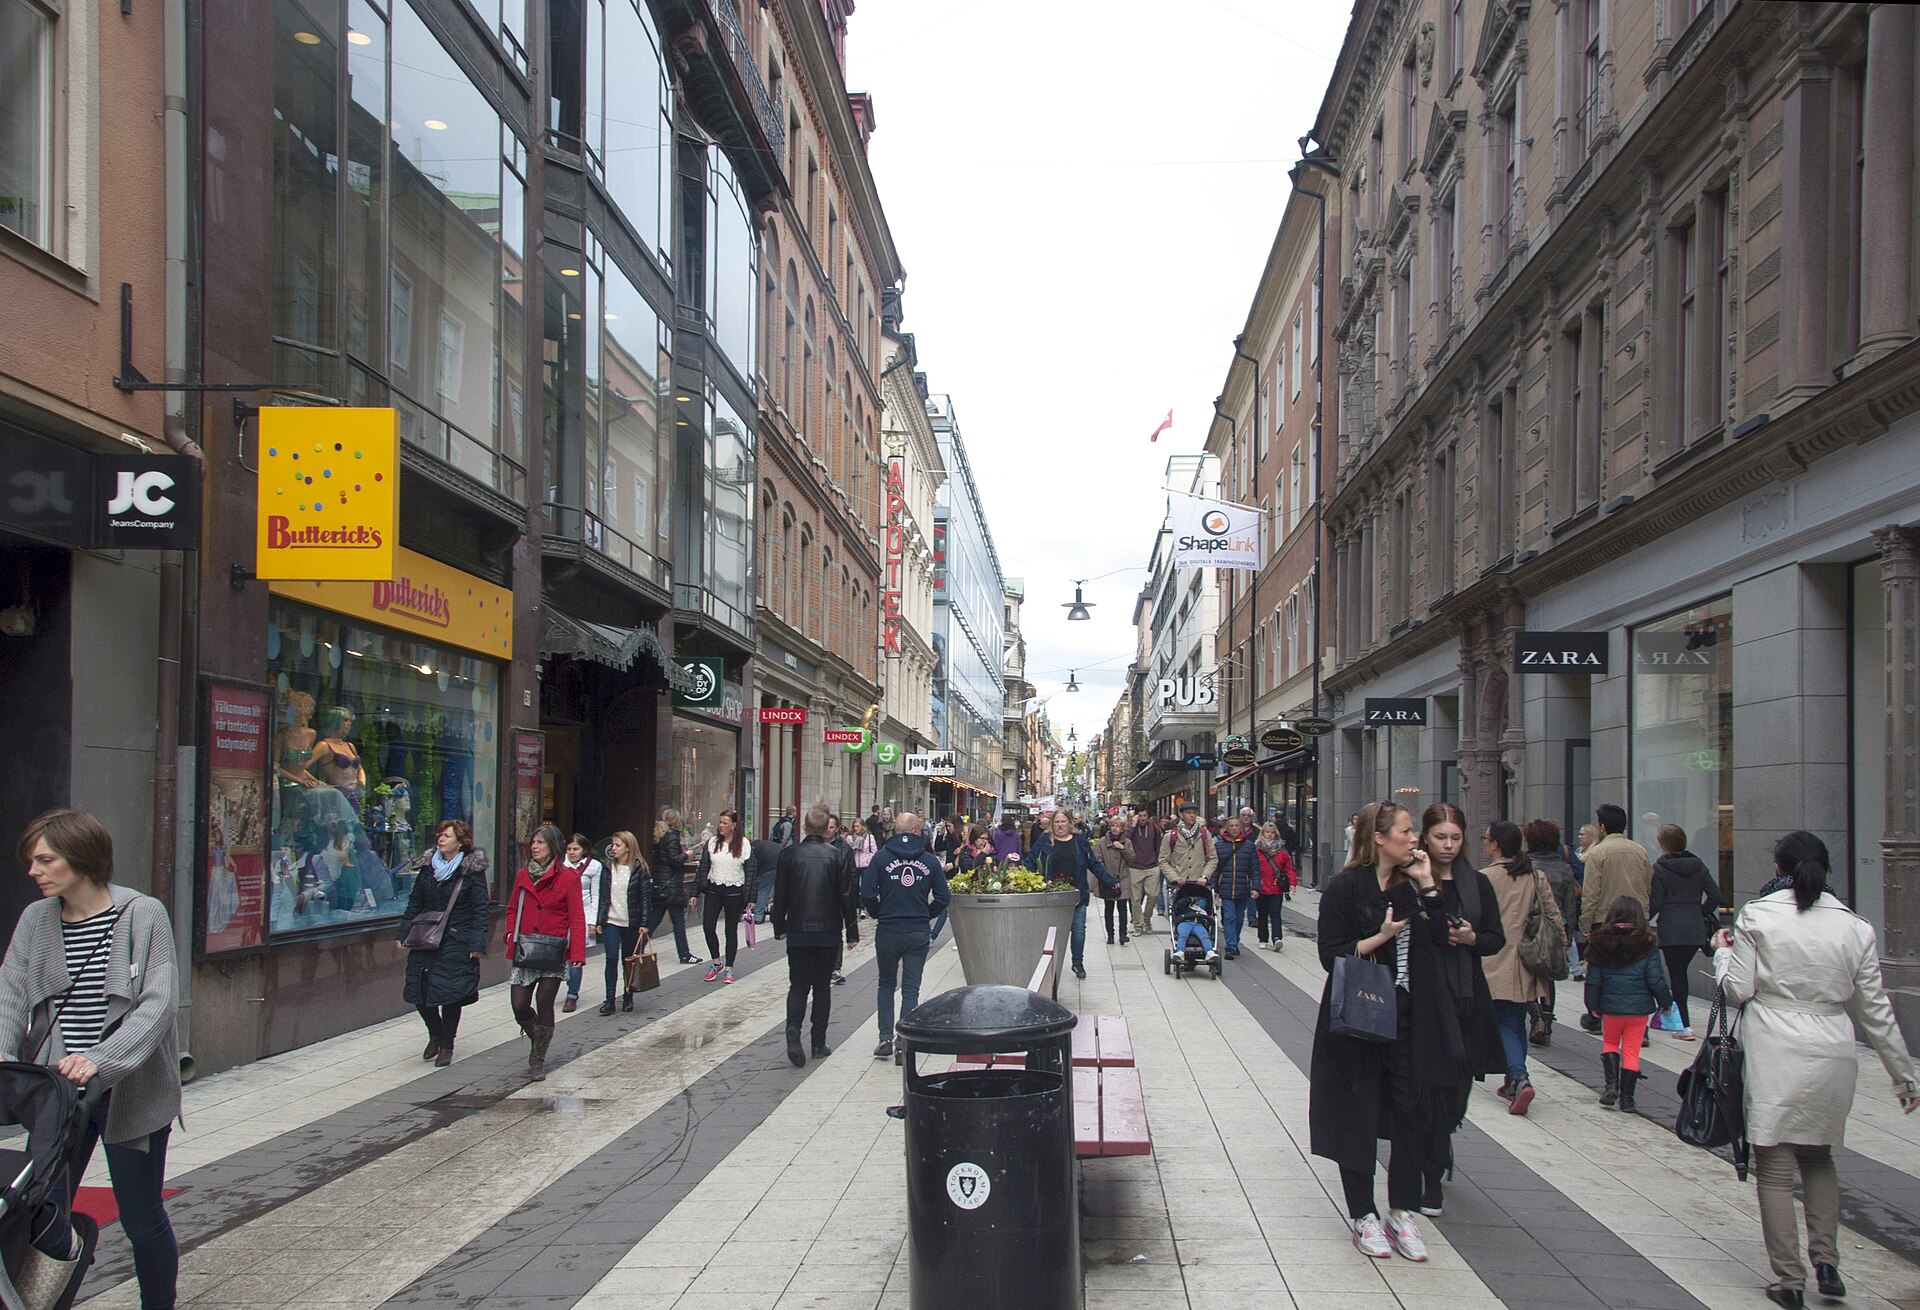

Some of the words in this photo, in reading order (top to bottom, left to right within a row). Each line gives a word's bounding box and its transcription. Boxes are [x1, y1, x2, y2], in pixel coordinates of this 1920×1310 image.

[108, 471, 175, 516] JC
[110, 519, 174, 529] JeansCompany
[268, 515, 383, 549] Butterick's
[1178, 535, 1255, 553] ShapeLink
[884, 461, 904, 653] APOTEK
[1521, 651, 1602, 665] ZARA
[1158, 677, 1214, 707] PUB
[762, 711, 802, 720] LINDEX
[1369, 711, 1422, 721] ZARA
[885, 859, 902, 873] SAIL
[903, 860, 930, 876] RACING
[1357, 990, 1385, 1004] ZARA
